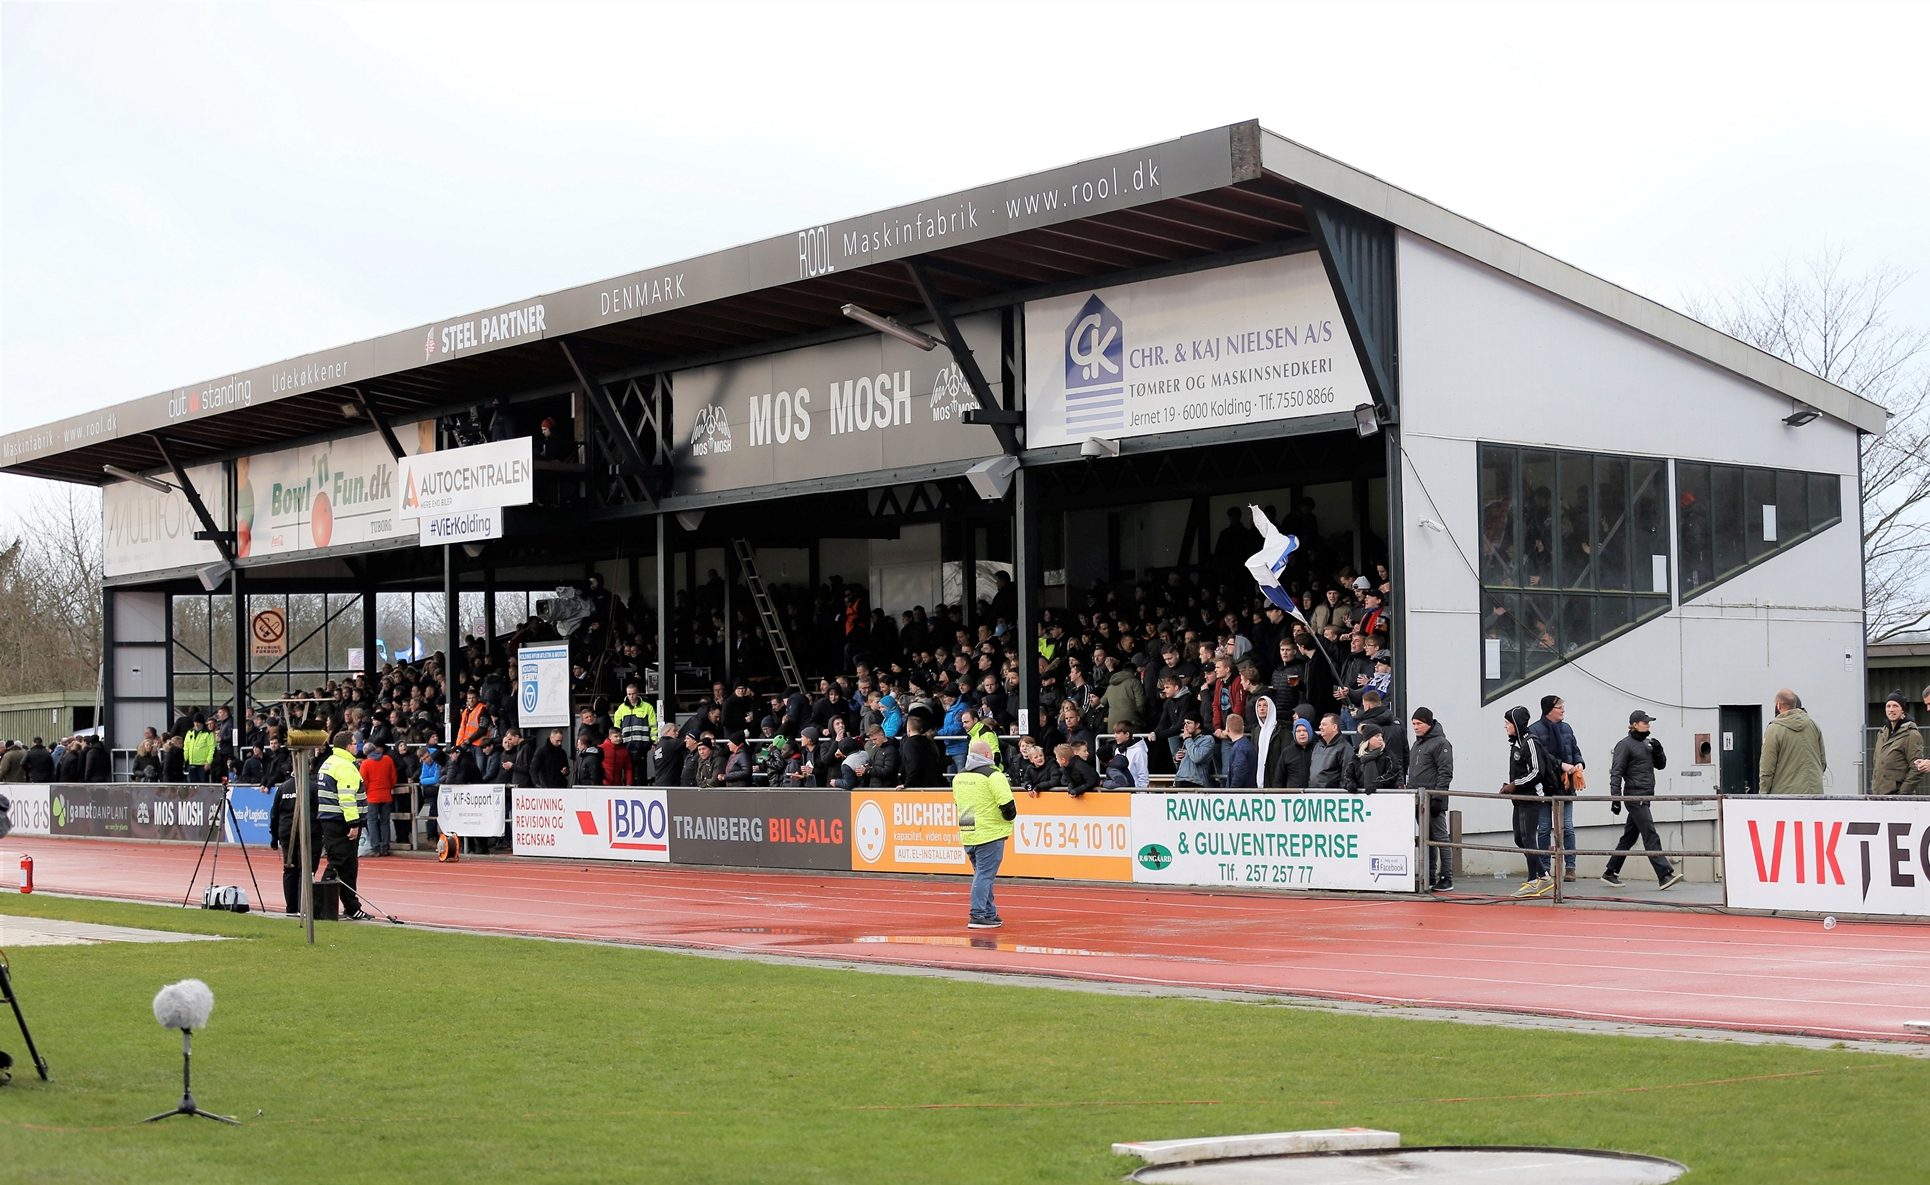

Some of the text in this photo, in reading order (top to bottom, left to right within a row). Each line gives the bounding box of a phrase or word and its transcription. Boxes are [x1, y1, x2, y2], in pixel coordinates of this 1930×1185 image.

[798, 158, 1160, 279] ROOL Maskinfabrik www.rool.dk
[601, 273, 685, 316] DENMARK
[441, 304, 547, 354] STEEL PARTNER
[1129, 320, 1332, 369] CHR. & KAJ NIELSEN A/S
[272, 360, 348, 393] Udekøkkener
[1129, 357, 1332, 398] TØMRER OG MASKINSNEDKERI
[168, 376, 251, 418] out standing
[749, 370, 912, 447] MOS MOSH
[1129, 386, 1335, 427] Jernet 19 6000 Kolding Tlf. 7550 8866
[932, 405, 951, 421] MOS
[3, 411, 117, 458] Maskinfabrik www.rool.dk
[693, 438, 732, 456] MOS MOSH
[271, 477, 312, 517] Bowl
[332, 463, 393, 507] Fun.dk
[420, 458, 530, 496] AUTOCENTRALEN
[430, 513, 491, 537] #ViErKolding
[153, 801, 204, 826] MOS MOSH
[453, 792, 492, 808] KIF-Support
[516, 795, 566, 813] RÅDGIVNING,
[1166, 798, 1372, 822] RAVNGAARD TØMRER-
[516, 815, 564, 829] REVISION OG
[614, 799, 667, 840] BDO
[893, 802, 959, 827] BUCHREI
[516, 833, 556, 847] REGNSKAB
[673, 815, 844, 845] TRANBERG BILSALG
[925, 833, 941, 841] viden
[942, 834, 952, 844] og
[1033, 822, 1126, 850] 76 34 10 10
[897, 848, 911, 859] AUT.
[1178, 831, 1359, 859] & GULVENTREPRISE
[1218, 863, 1314, 884] Tlf. 257 257 77
[1380, 863, 1405, 872] Facebook
